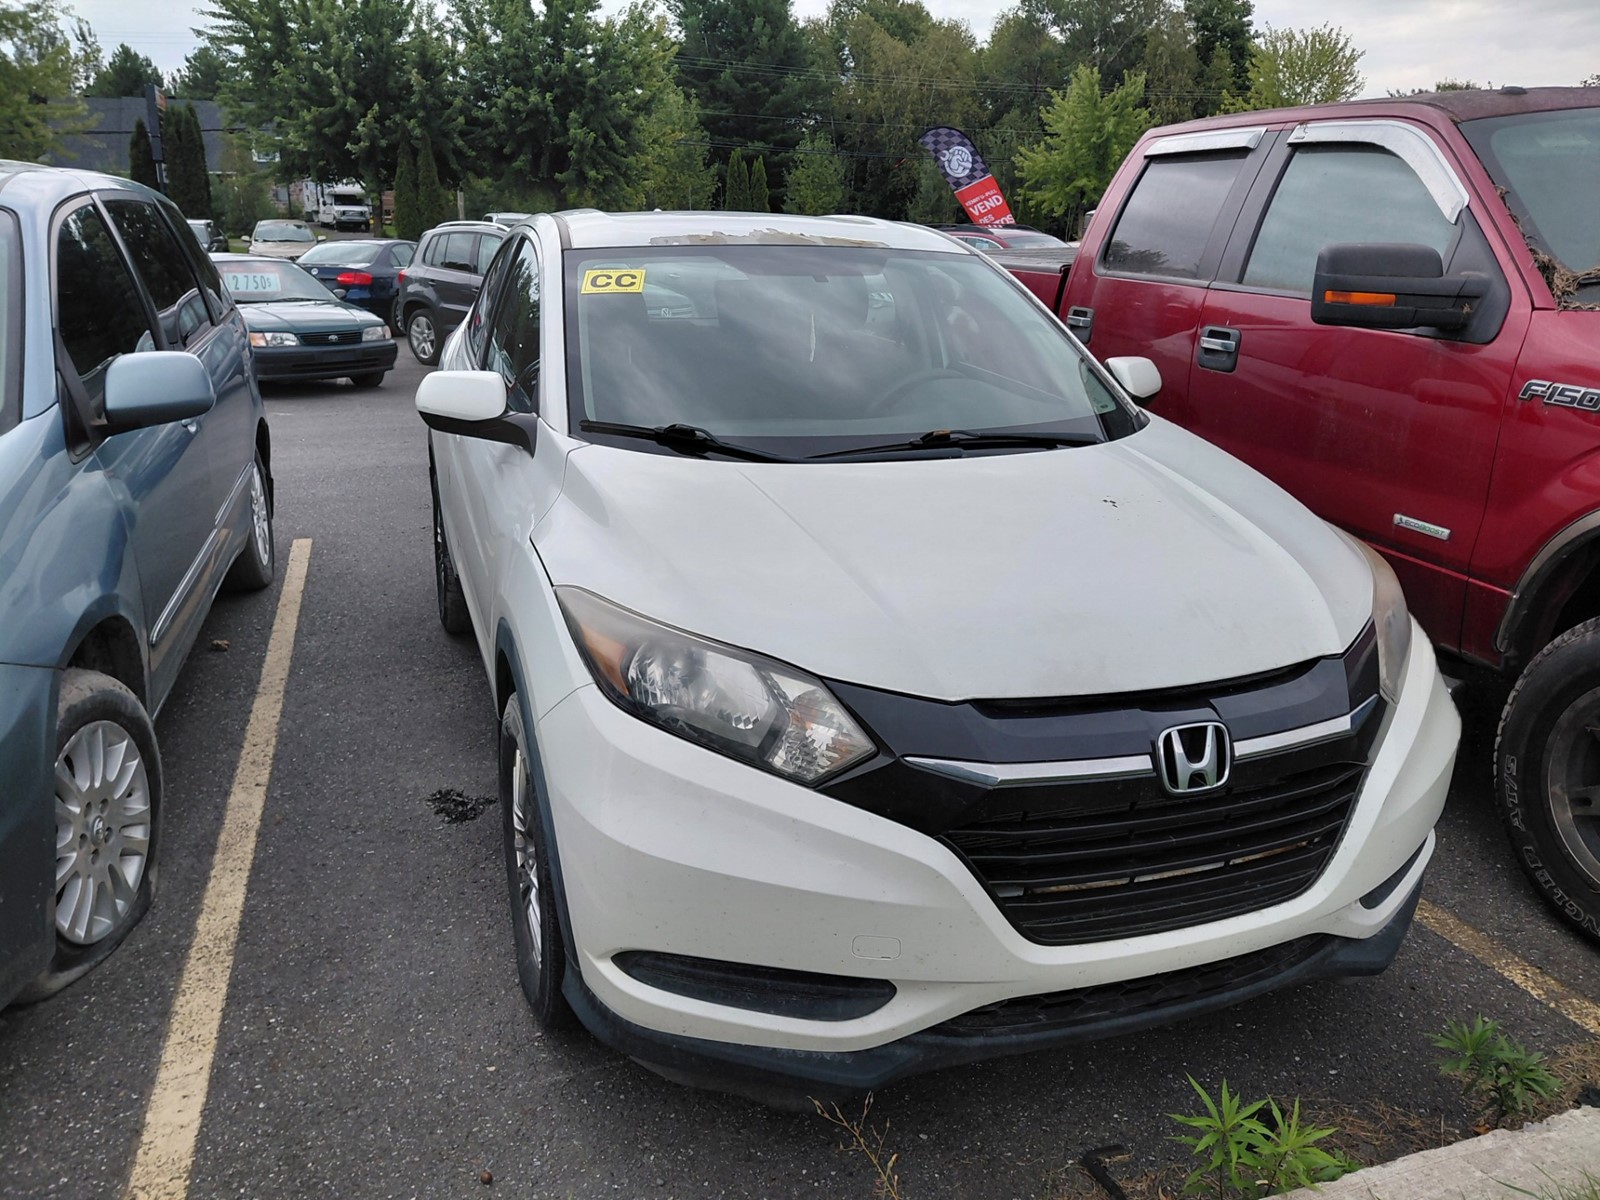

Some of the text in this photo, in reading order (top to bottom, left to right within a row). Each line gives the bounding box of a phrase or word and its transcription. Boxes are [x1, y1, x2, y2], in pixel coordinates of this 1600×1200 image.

[969, 195, 1002, 215] VEND
[978, 214, 995, 224] DES
[590, 273, 637, 288] CC
[1518, 379, 1600, 412] F-150
